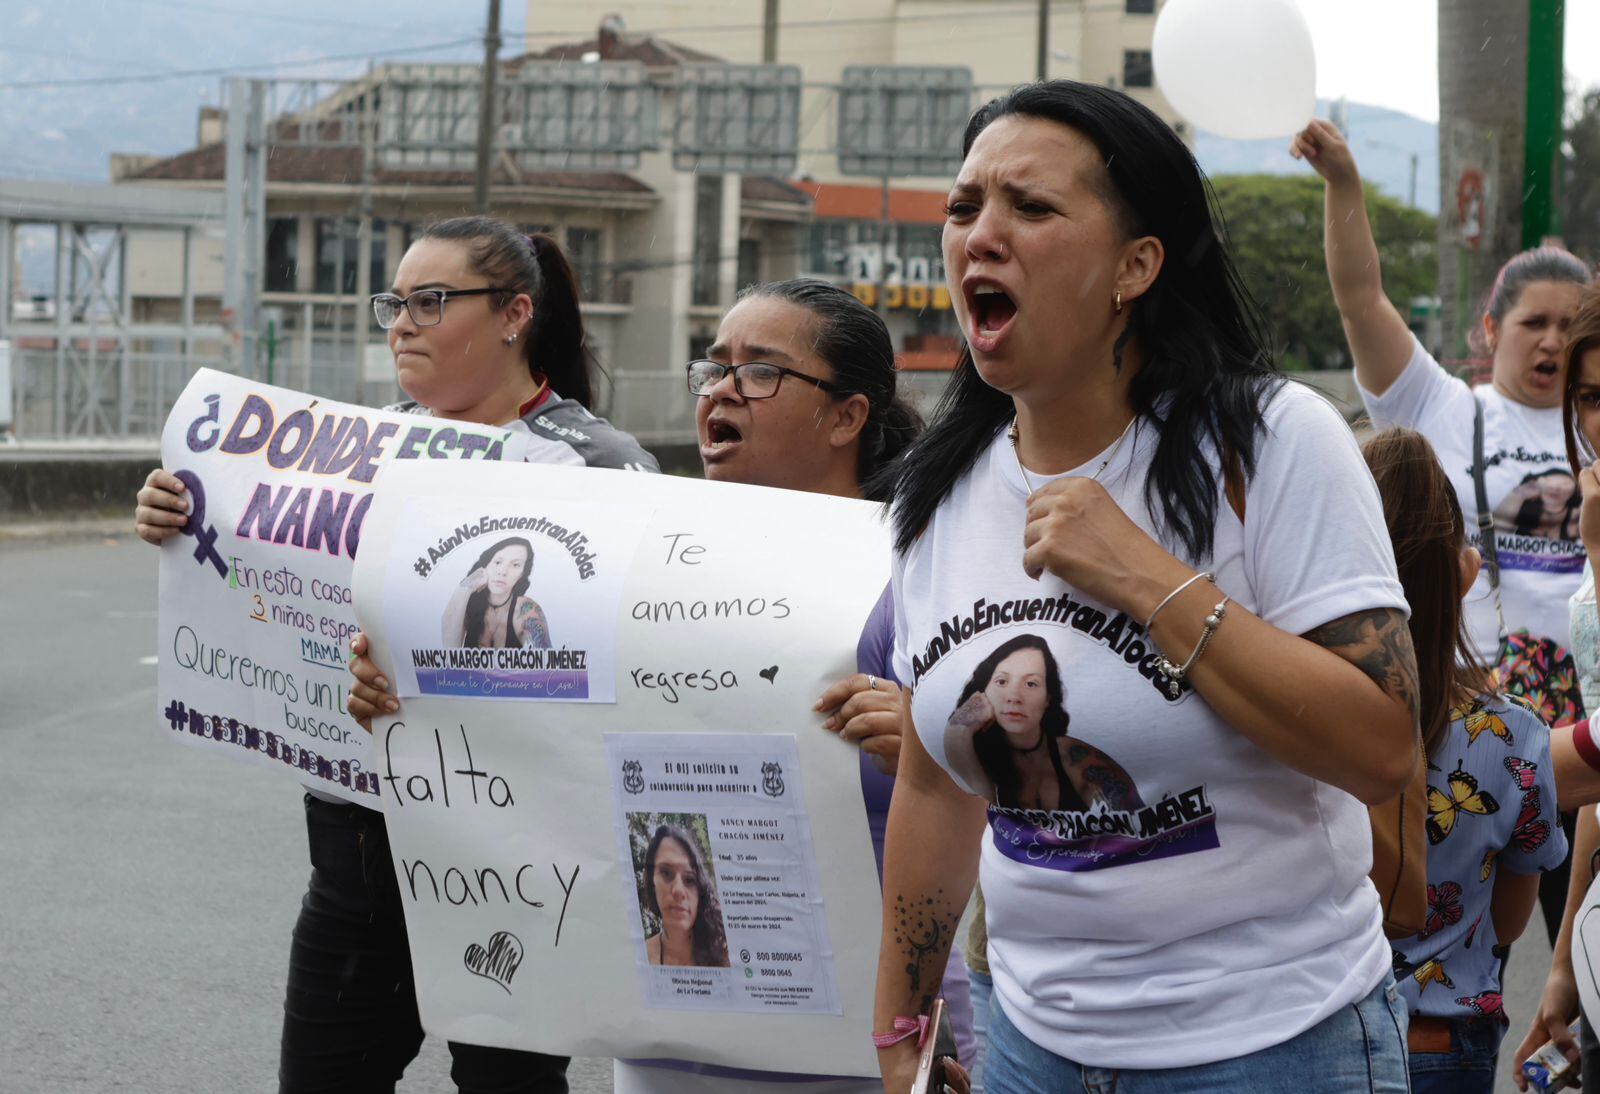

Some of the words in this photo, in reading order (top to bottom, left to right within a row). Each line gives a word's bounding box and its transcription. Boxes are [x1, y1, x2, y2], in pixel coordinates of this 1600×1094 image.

[663, 533, 707, 566] Te
[1497, 534, 1546, 554] MARGOT
[262, 566, 303, 598] esta
[251, 594, 267, 622] 3
[271, 602, 315, 634] niñas
[632, 597, 792, 624] amamos
[173, 624, 299, 703] Queremos
[304, 679, 333, 712] un
[411, 649, 447, 669] NANCY
[450, 650, 495, 670] MARGOT
[497, 645, 544, 670] CHACÓN
[546, 645, 587, 670] JIMÉNEZ
[630, 667, 739, 704] regresa
[383, 721, 515, 809] falta
[664, 762, 674, 774] El
[692, 762, 727, 775] solicita
[729, 764, 739, 775] su
[697, 783, 714, 793] para
[715, 783, 750, 793] encontrar
[718, 831, 750, 841] CHACÓN
[752, 832, 785, 841] JIMÉNEZ
[720, 818, 745, 827] NANCY
[747, 819, 779, 828] MARGOT
[401, 858, 581, 948] nancy
[756, 952, 770, 961] 800
[771, 952, 803, 962] 8000645
